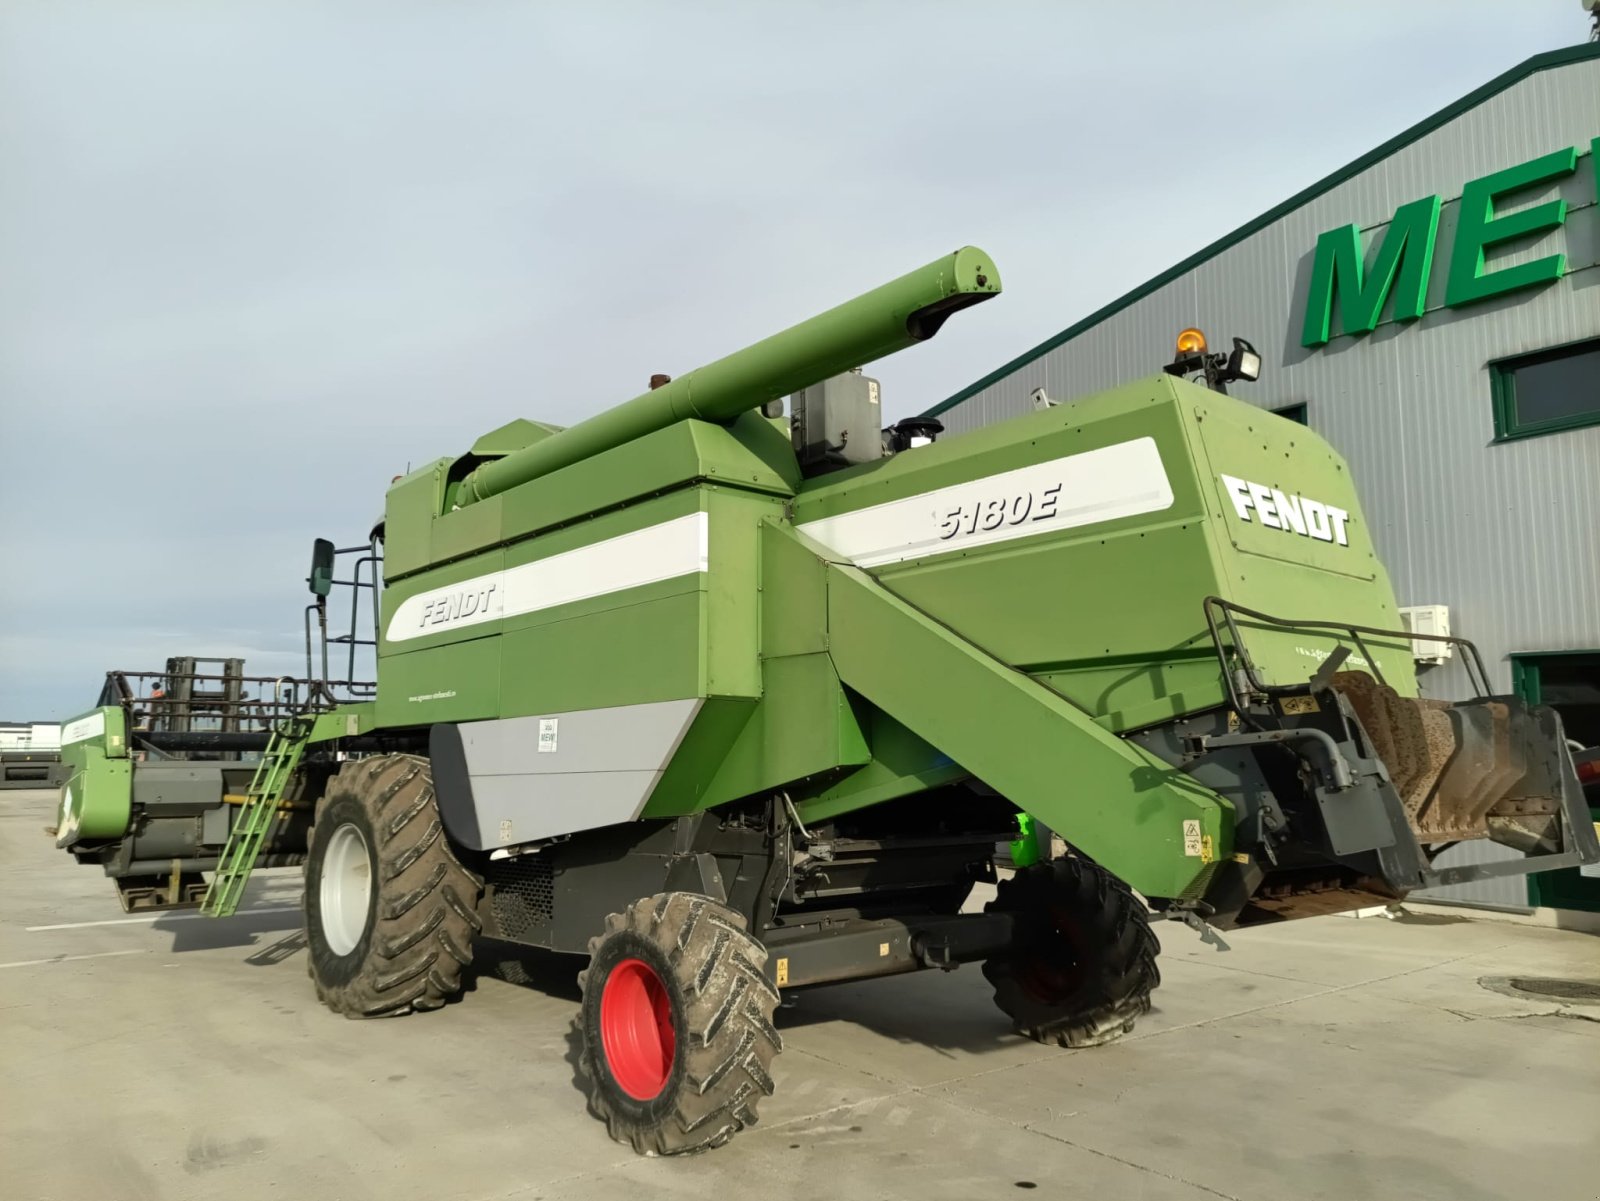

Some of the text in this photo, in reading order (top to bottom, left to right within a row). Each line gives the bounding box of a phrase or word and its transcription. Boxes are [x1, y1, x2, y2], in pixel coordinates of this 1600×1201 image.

[1301, 137, 1600, 348] ME
[935, 482, 1062, 540] 5180E
[1221, 473, 1349, 548] FENDT
[419, 585, 496, 627] FENDT
